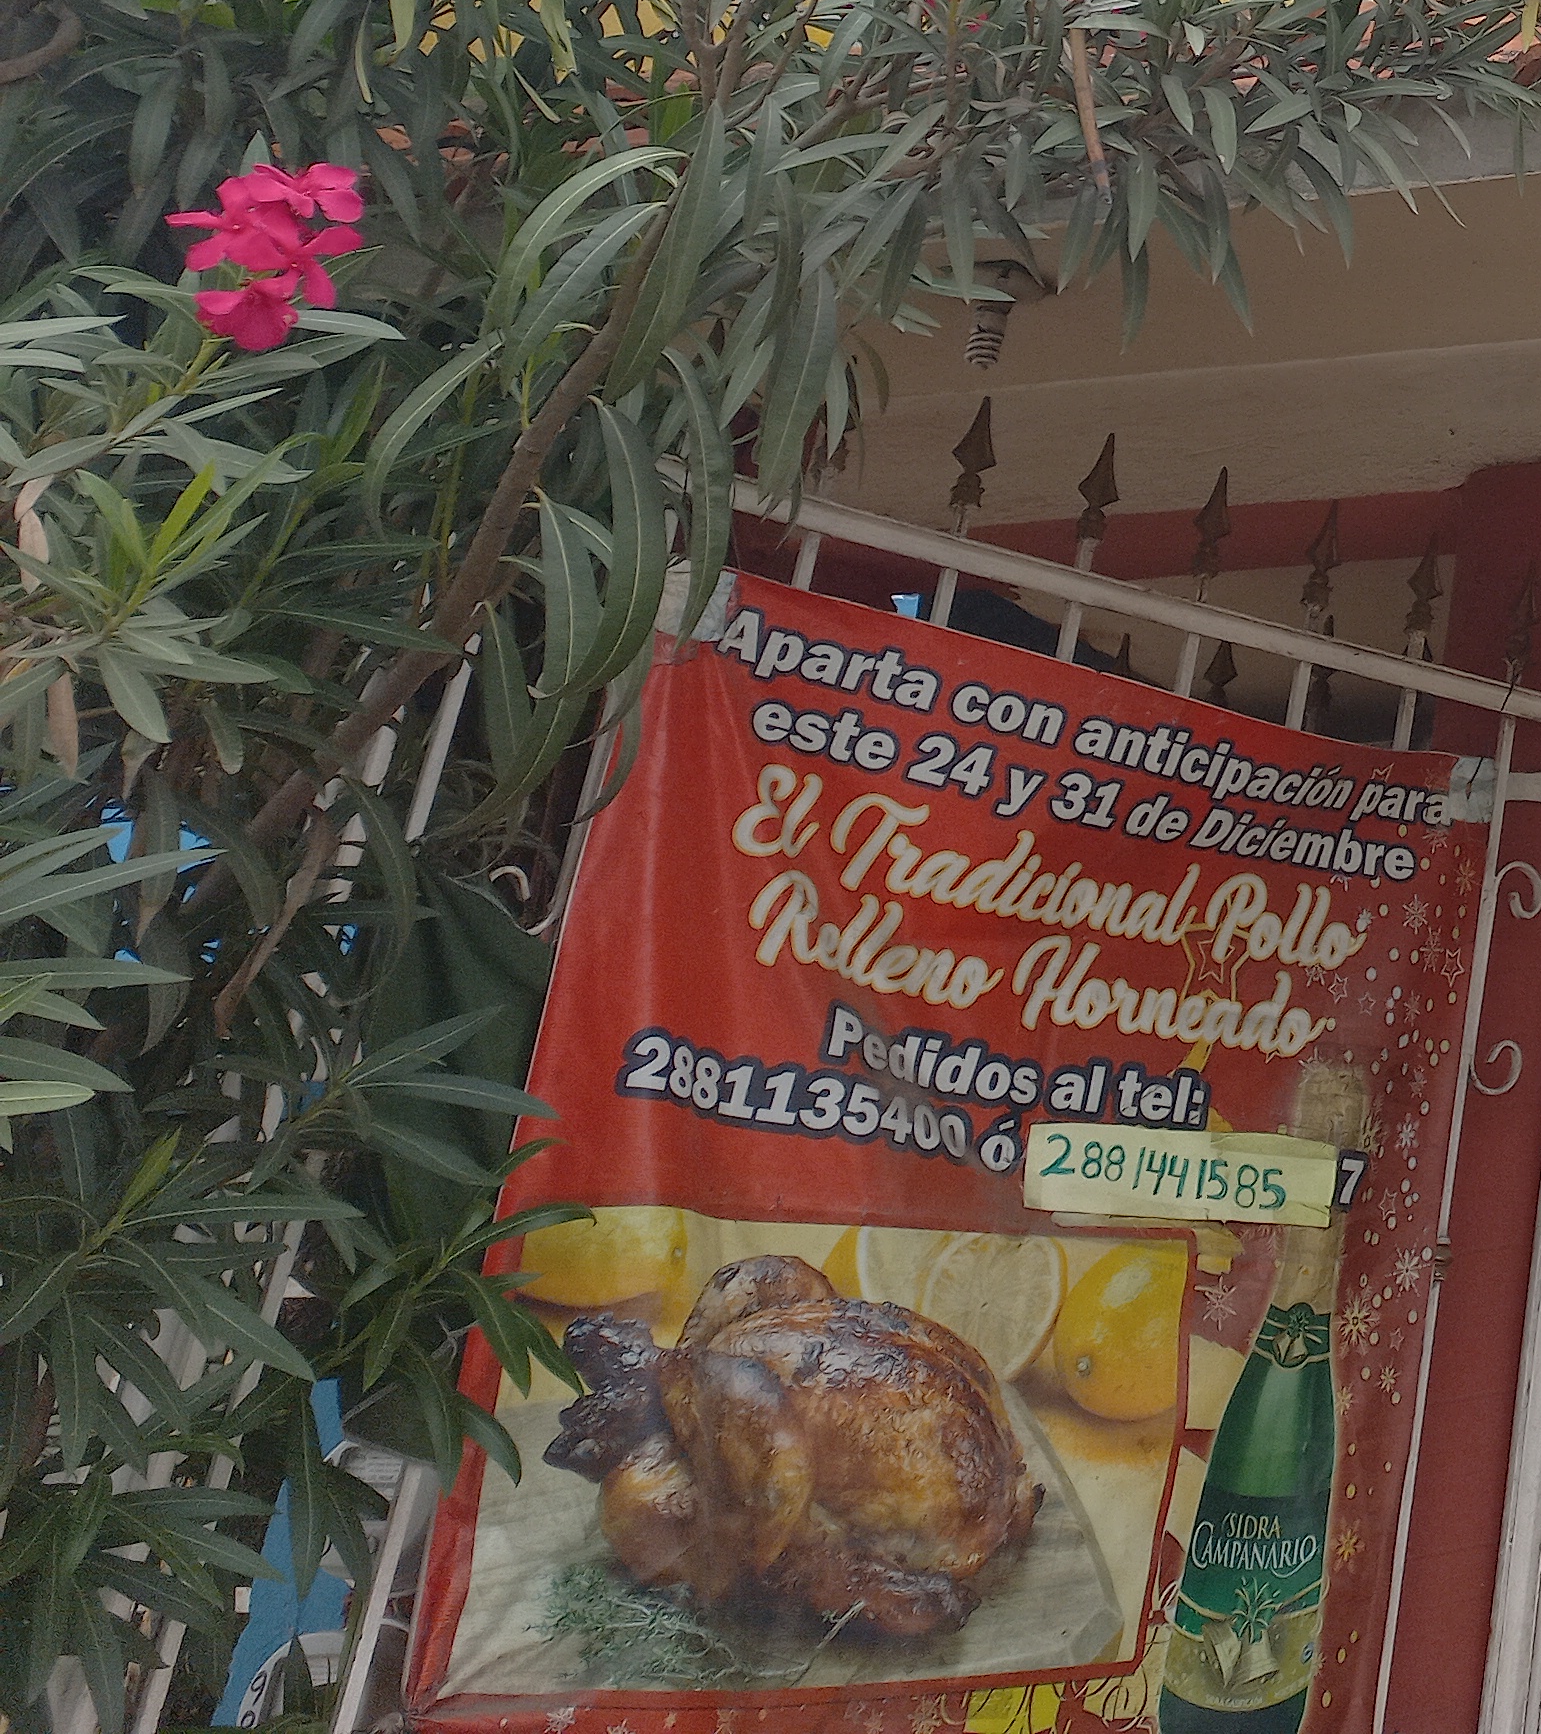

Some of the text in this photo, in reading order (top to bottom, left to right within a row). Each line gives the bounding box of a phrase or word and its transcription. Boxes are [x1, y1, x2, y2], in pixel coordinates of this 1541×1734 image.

[716, 607, 1453, 827] Aparta con anticipación para
[751, 701, 1415, 881] este 24 y 31 de Diciembre
[731, 763, 1367, 971] El Tradicional Pollo
[748, 868, 1326, 1056] Relleno Horneado
[625, 1035, 967, 1159] 2881135400
[827, 1006, 1205, 1126] Pedidos al tel:
[1223, 1512, 1282, 1540] SIDRA
